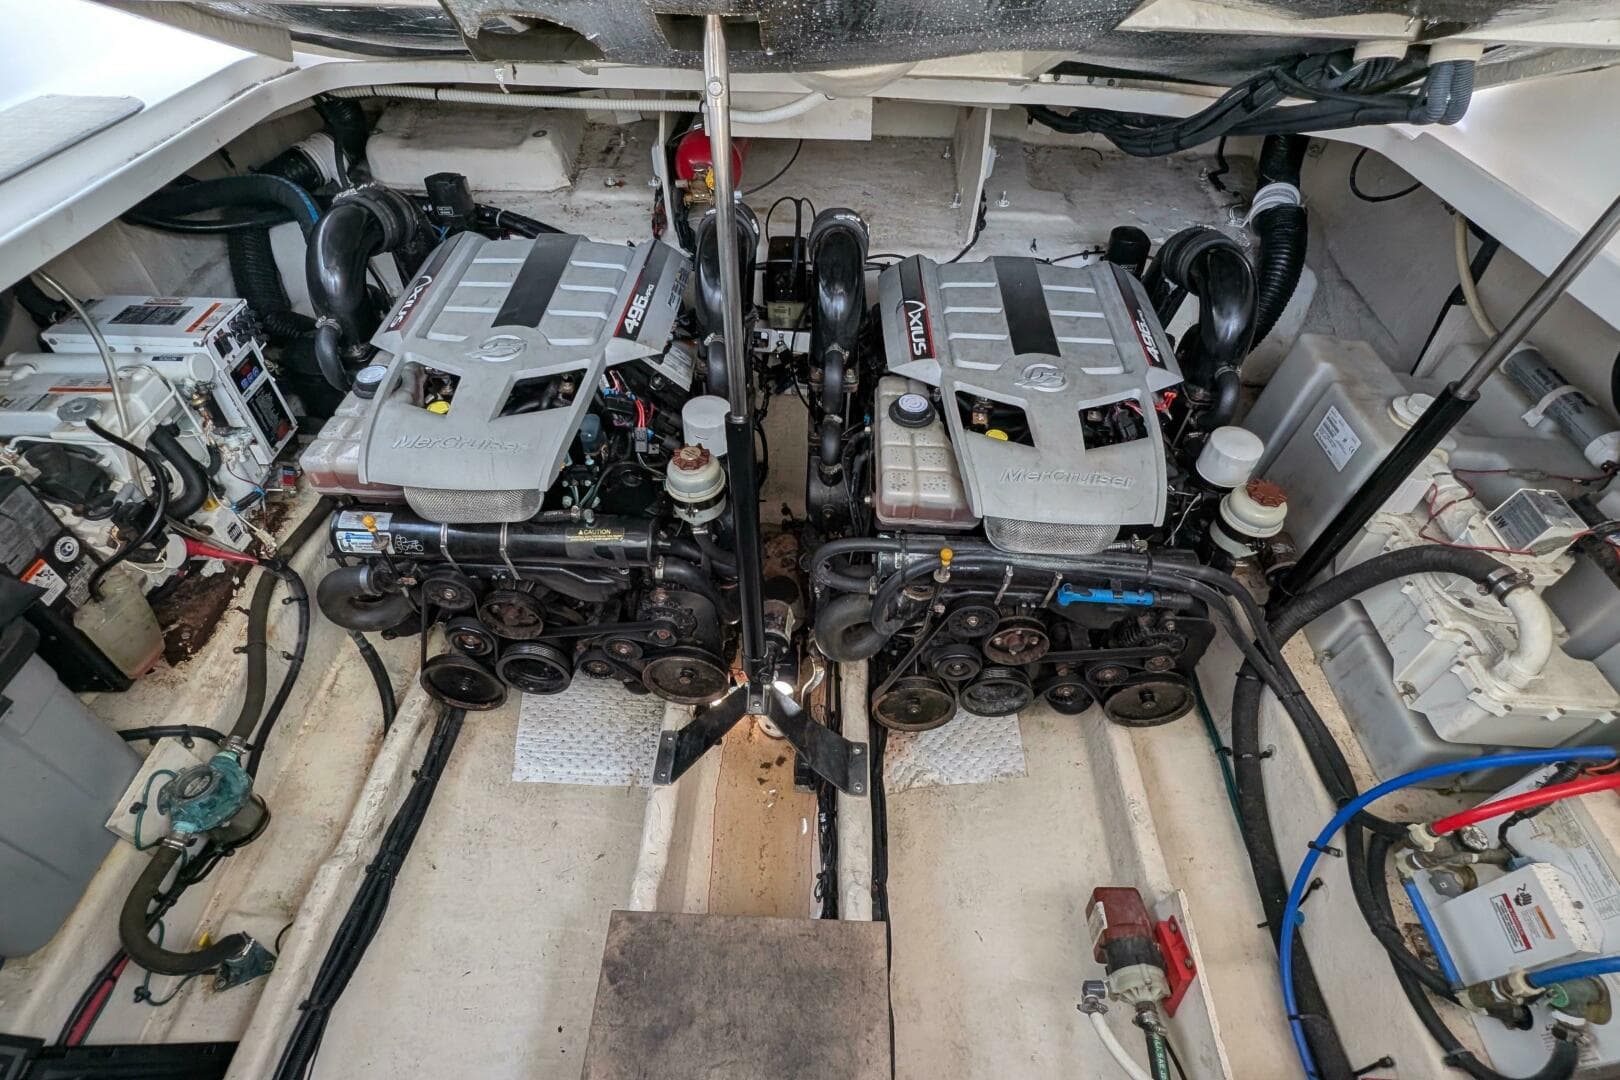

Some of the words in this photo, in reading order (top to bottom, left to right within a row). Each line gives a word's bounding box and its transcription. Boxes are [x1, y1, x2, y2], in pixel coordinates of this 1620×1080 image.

[390, 275, 433, 328] AXIUS
[624, 294, 648, 334] 496
[903, 300, 927, 356] AXIUS
[999, 468, 1135, 490] MerCruiser
